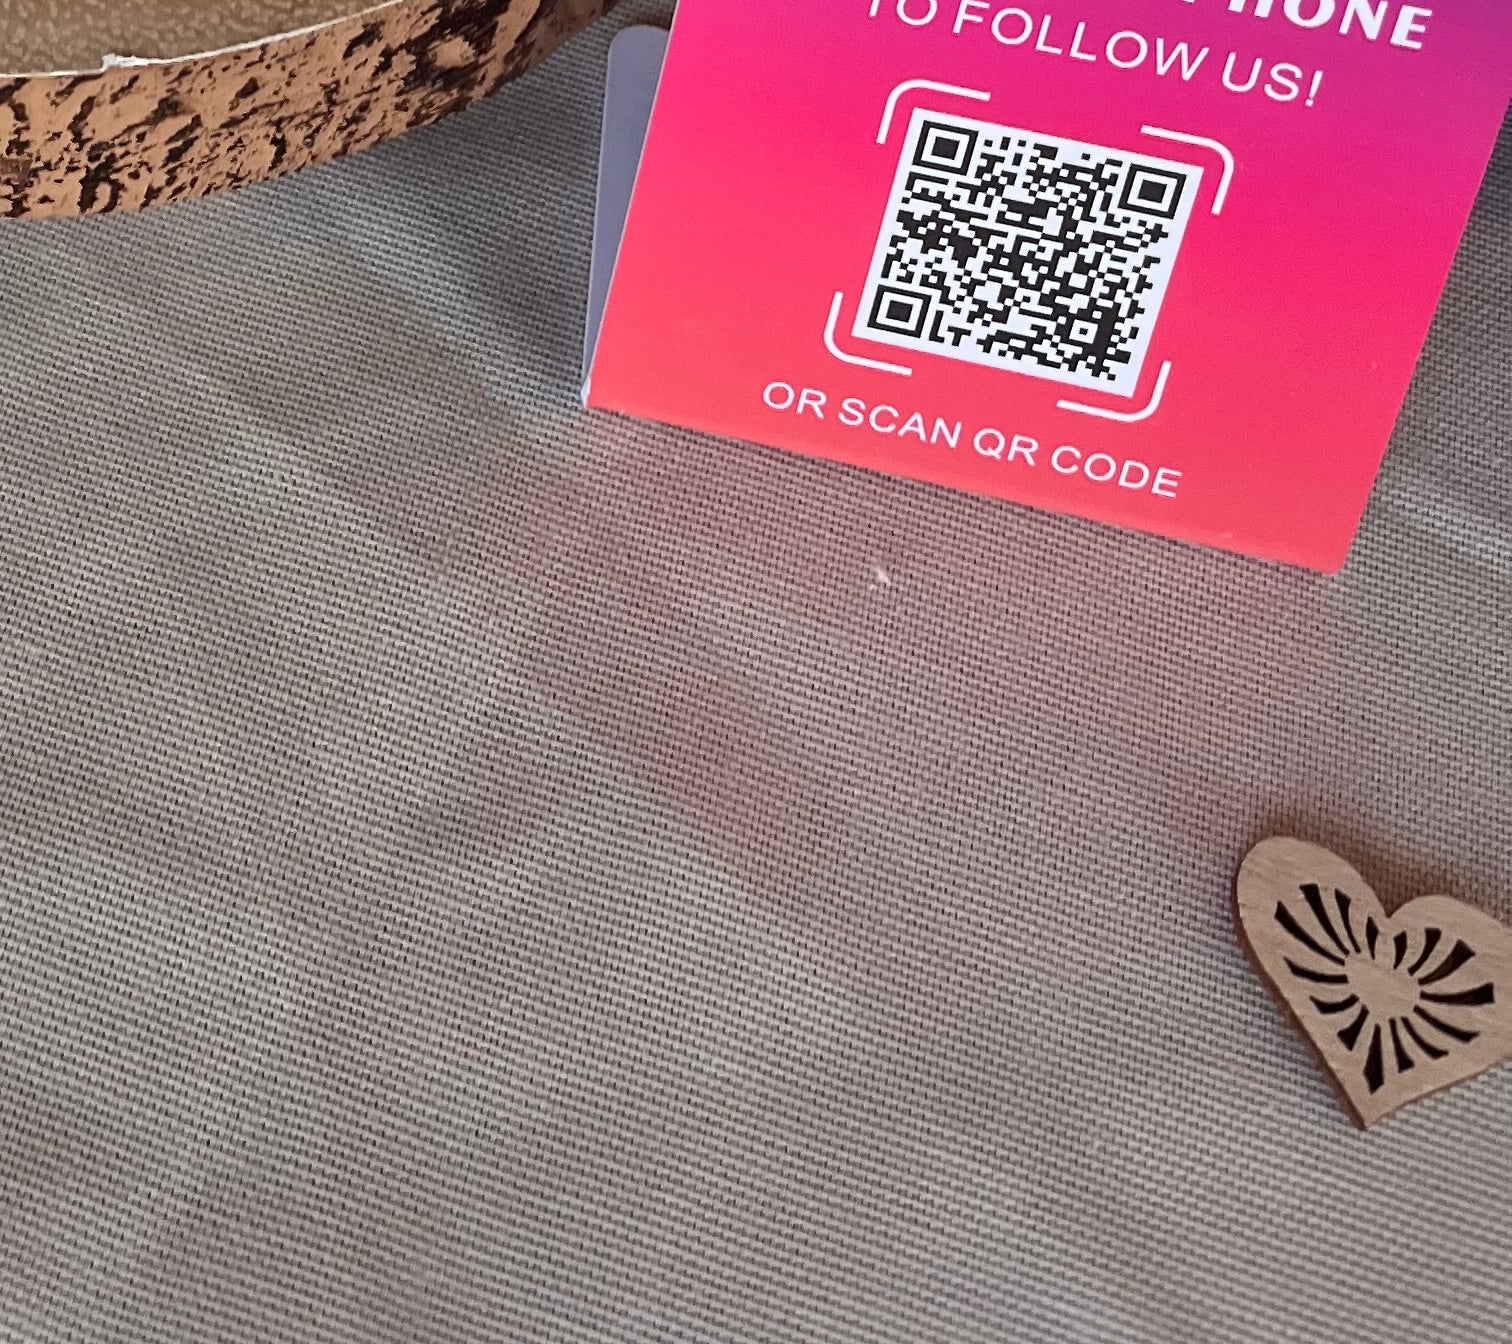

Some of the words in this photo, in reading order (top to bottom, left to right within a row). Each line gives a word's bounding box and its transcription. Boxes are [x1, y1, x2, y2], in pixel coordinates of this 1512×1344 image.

[953, 0, 1210, 81] FOLLOW
[1223, 44, 1325, 108] US!
[763, 380, 826, 419] OR
[837, 397, 962, 449] SCAN
[973, 426, 1039, 468] QR
[1050, 444, 1183, 498] CODE
